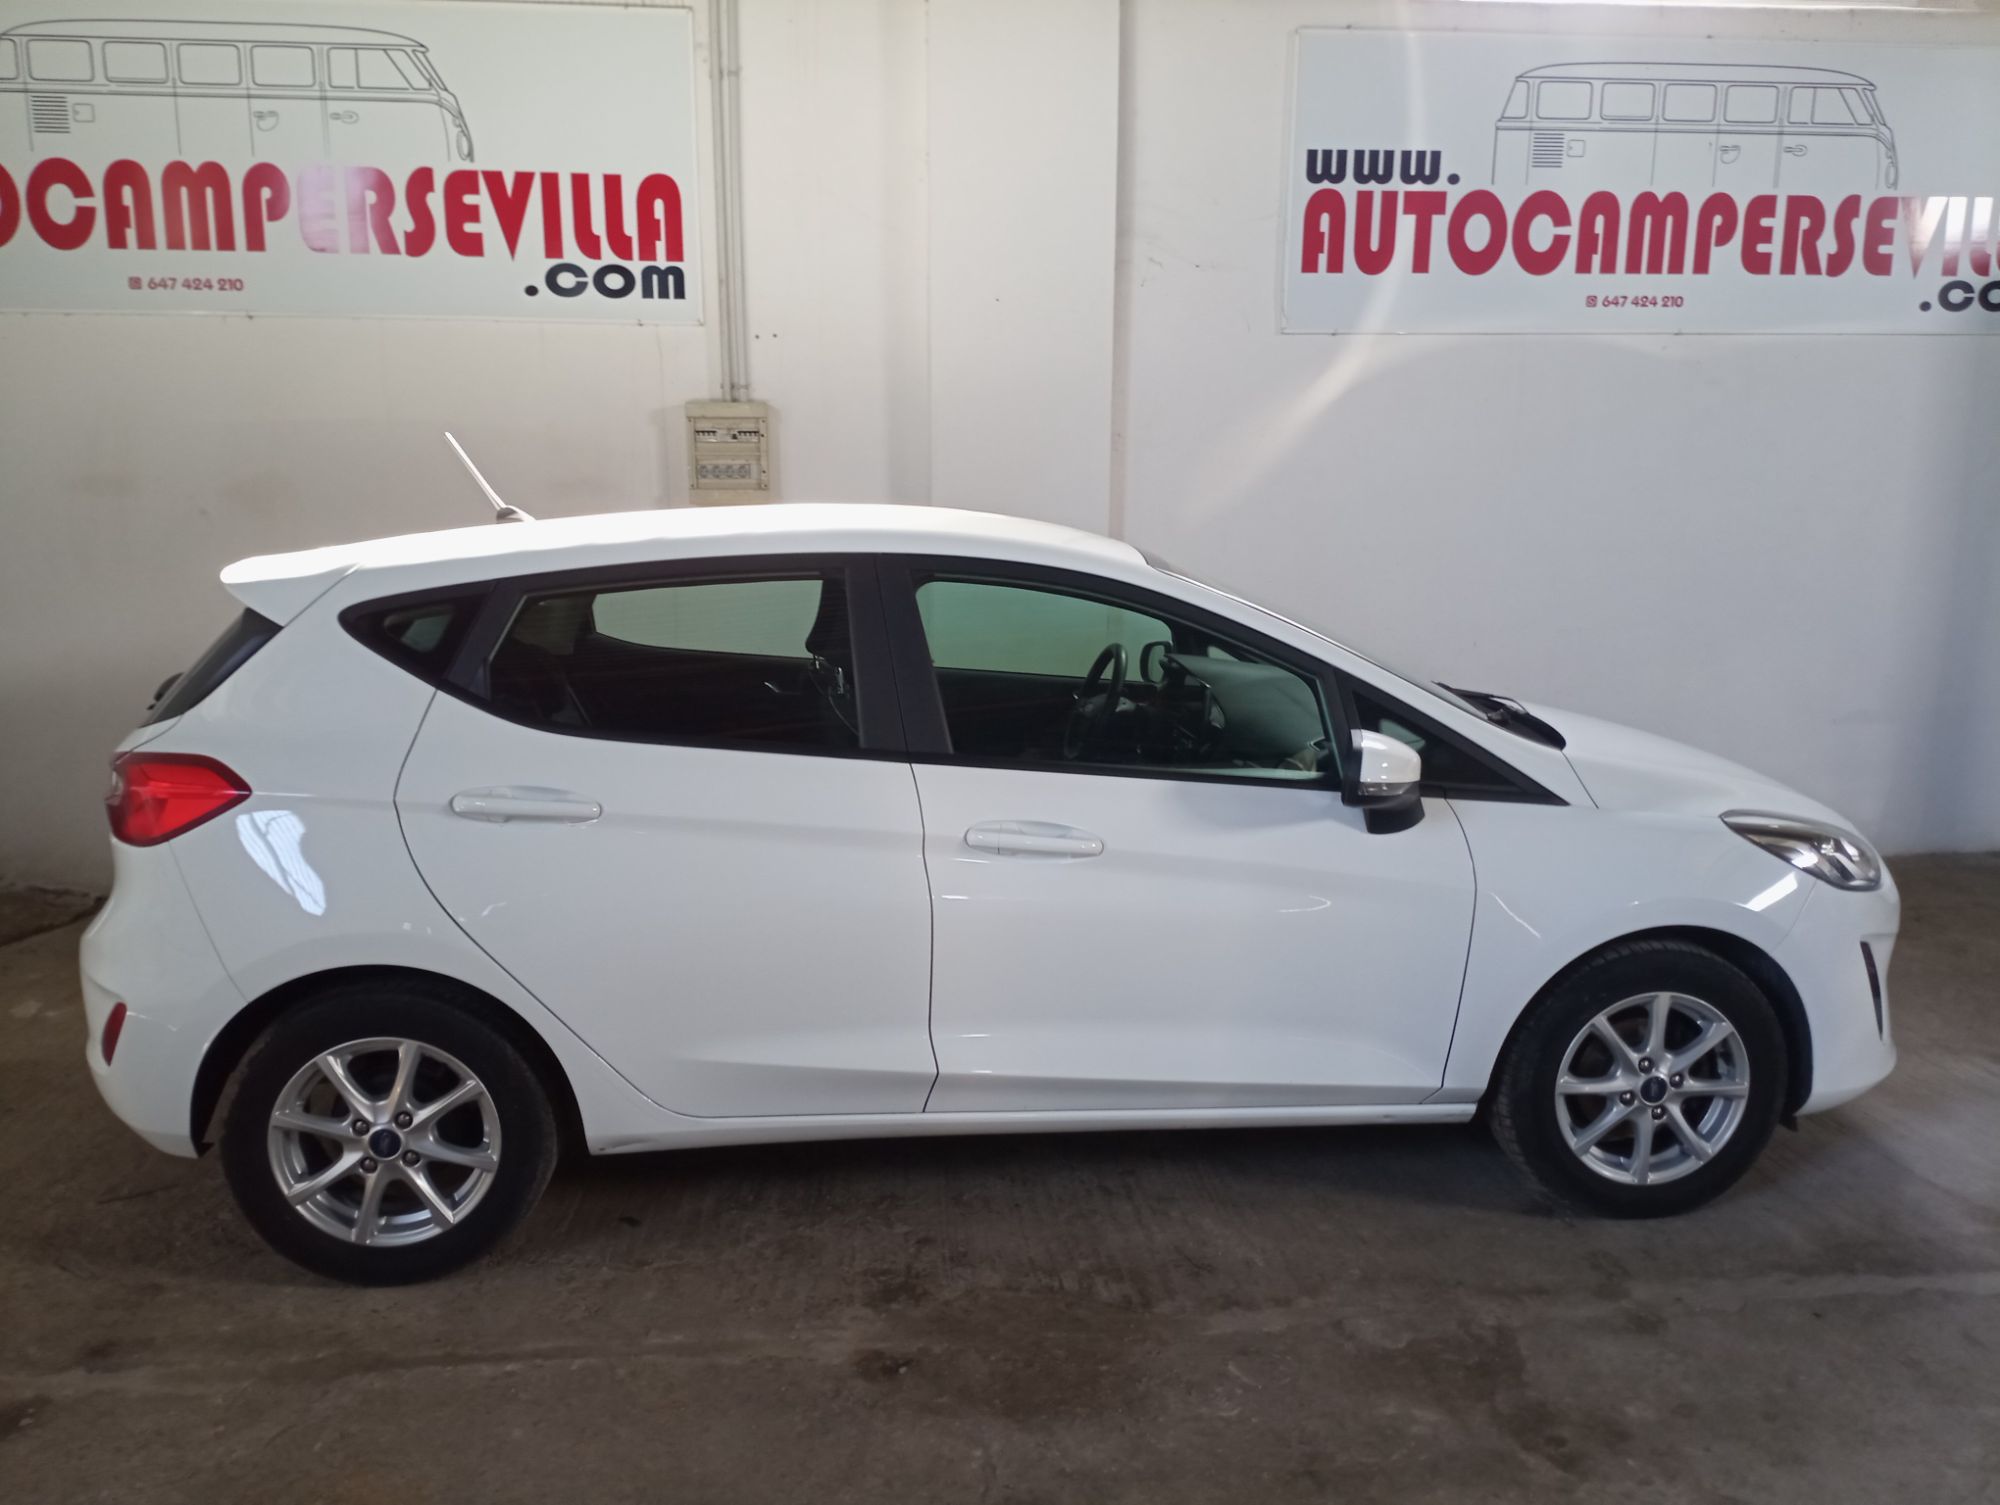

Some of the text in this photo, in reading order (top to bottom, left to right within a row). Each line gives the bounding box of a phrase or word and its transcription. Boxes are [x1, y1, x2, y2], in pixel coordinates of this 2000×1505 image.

[1306, 148, 1460, 185] www.
[1301, 188, 2000, 280] AUTOCAMPERSEVIL
[147, 277, 244, 291] 647 424 210
[1602, 295, 1684, 307] 647 424 210
